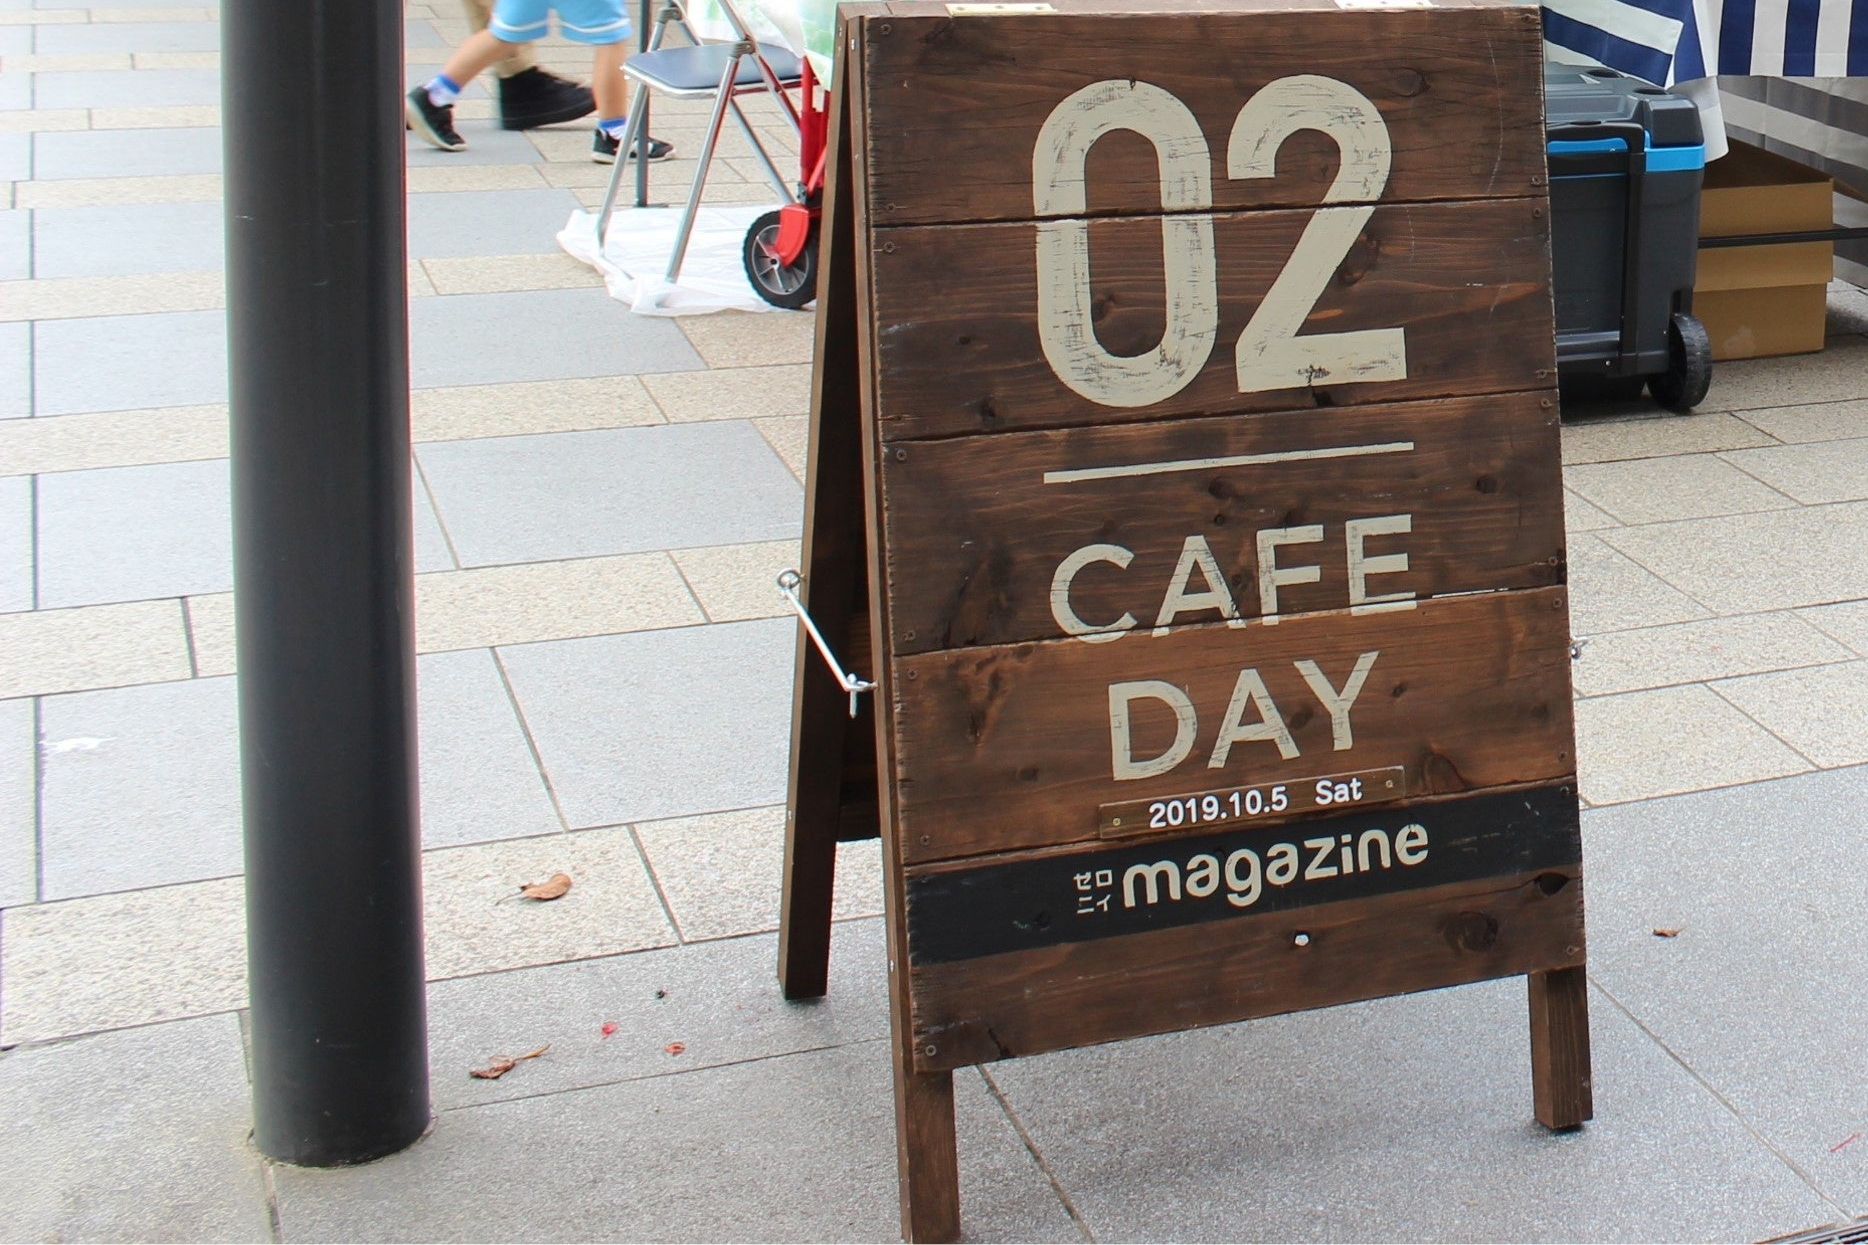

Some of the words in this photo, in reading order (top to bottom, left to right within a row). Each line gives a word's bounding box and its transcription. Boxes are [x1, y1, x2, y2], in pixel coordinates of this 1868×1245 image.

[1032, 73, 1408, 408] 02
[1049, 513, 1418, 645] CAFE
[1107, 650, 1380, 782] DAY
[1073, 869, 1113, 890] ゼロ
[1122, 822, 1429, 907] magazine
[1149, 785, 1289, 828] 2019.10.5
[1315, 777, 1363, 805] Sat
